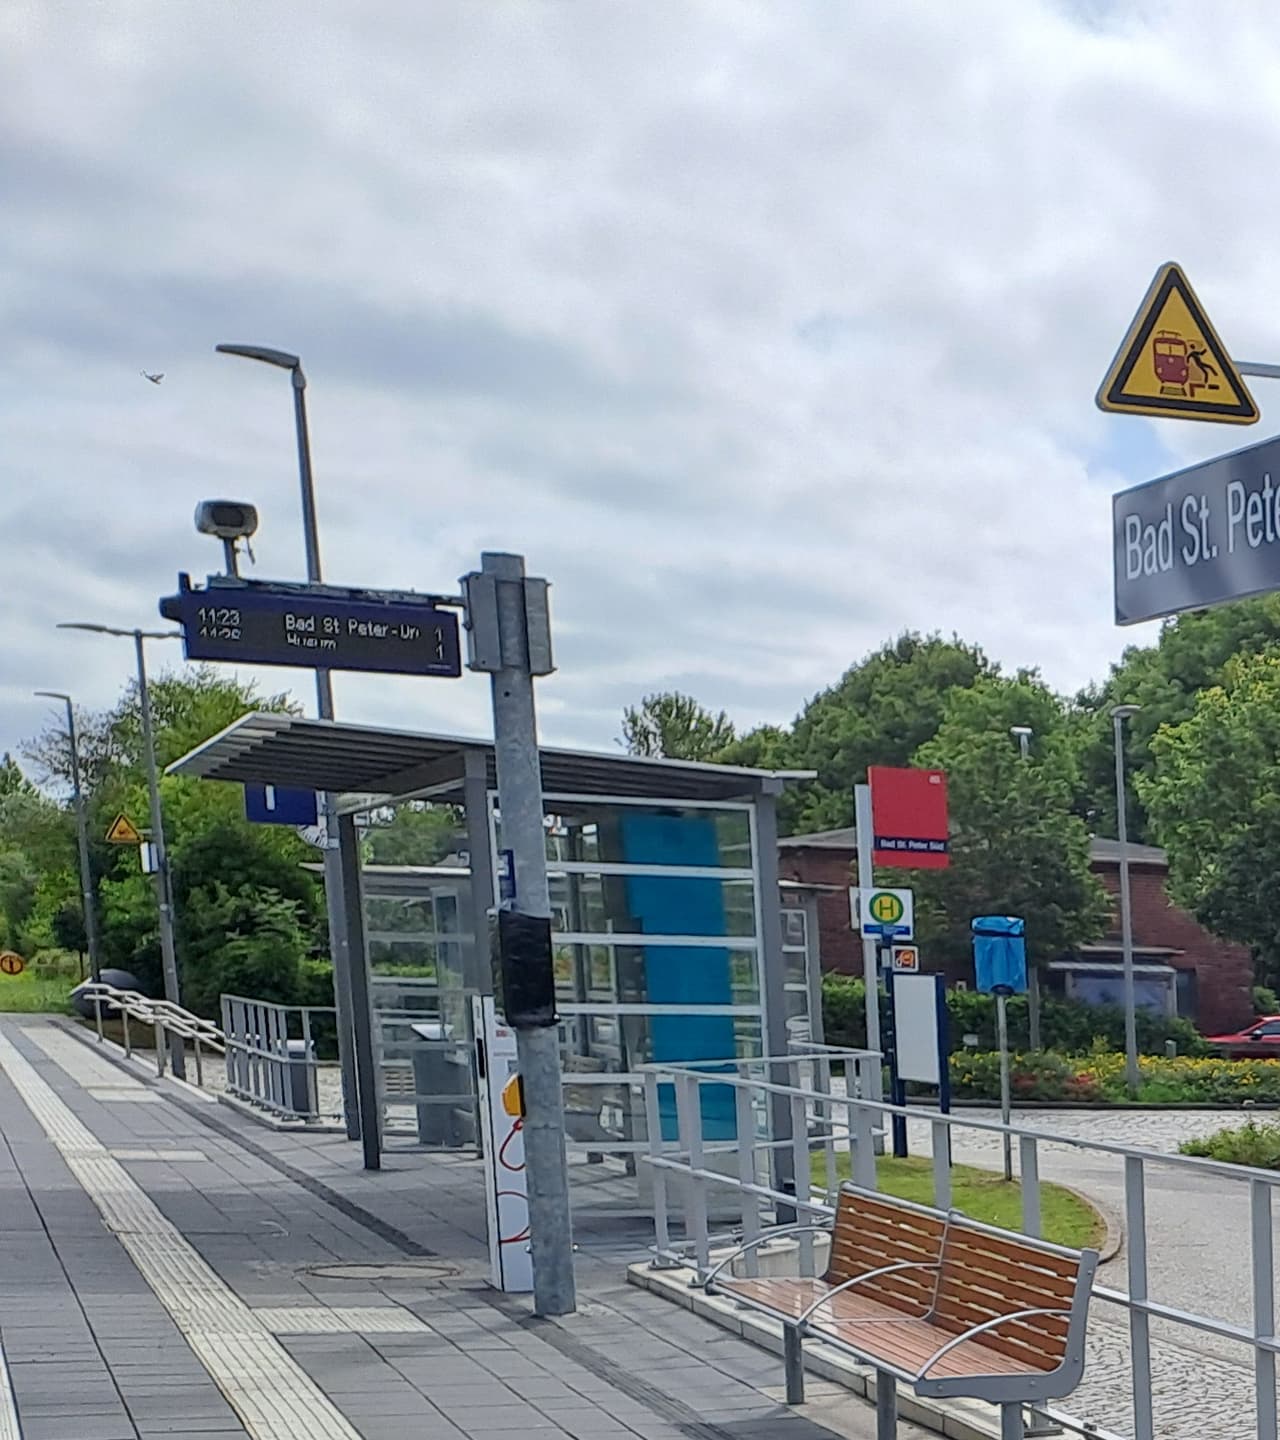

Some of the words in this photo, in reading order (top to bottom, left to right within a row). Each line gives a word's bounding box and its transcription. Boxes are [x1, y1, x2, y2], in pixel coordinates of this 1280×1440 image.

[1124, 502, 1174, 581] Bad
[1181, 494, 1218, 566] St.
[285, 613, 315, 632] Bad
[879, 898, 895, 918] H
